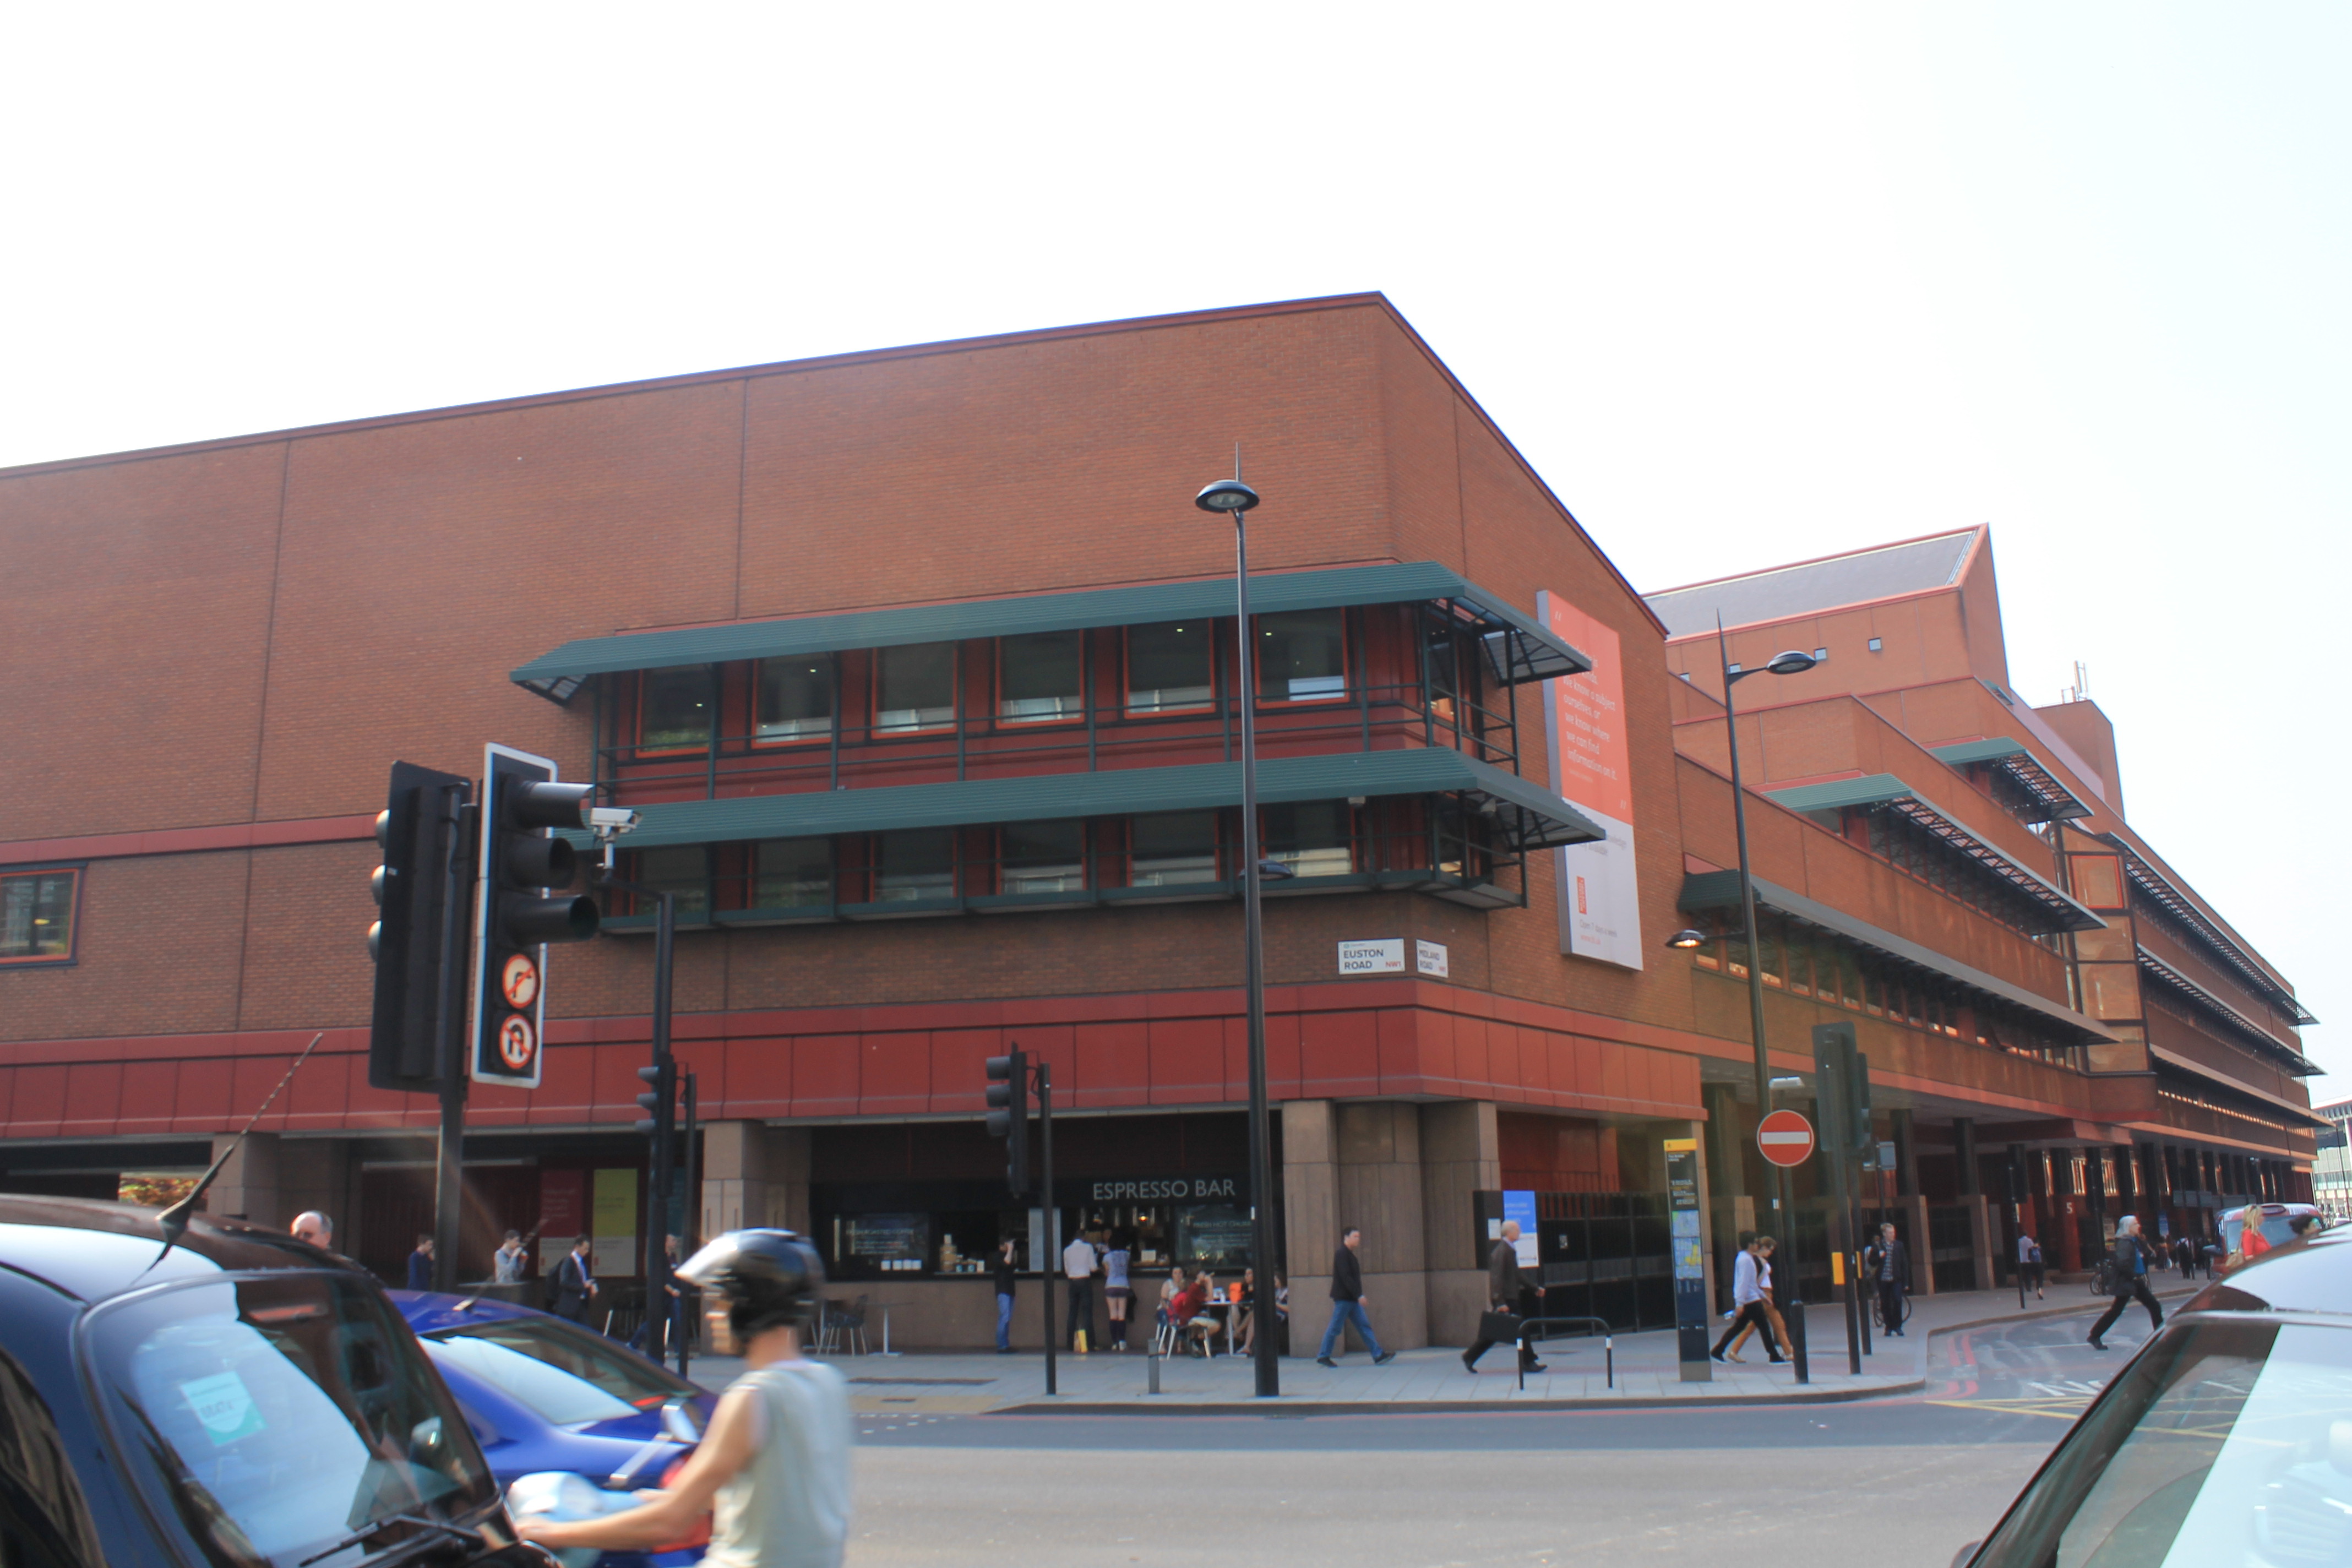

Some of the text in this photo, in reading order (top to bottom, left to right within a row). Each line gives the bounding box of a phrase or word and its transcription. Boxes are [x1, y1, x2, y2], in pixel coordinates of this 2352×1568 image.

[1343, 949, 1384, 959] EUSTON
[1344, 961, 1372, 970] ROAD
[1093, 1179, 1235, 1200] ESPRESSO BAR
[2066, 1202, 2073, 1214] 5
